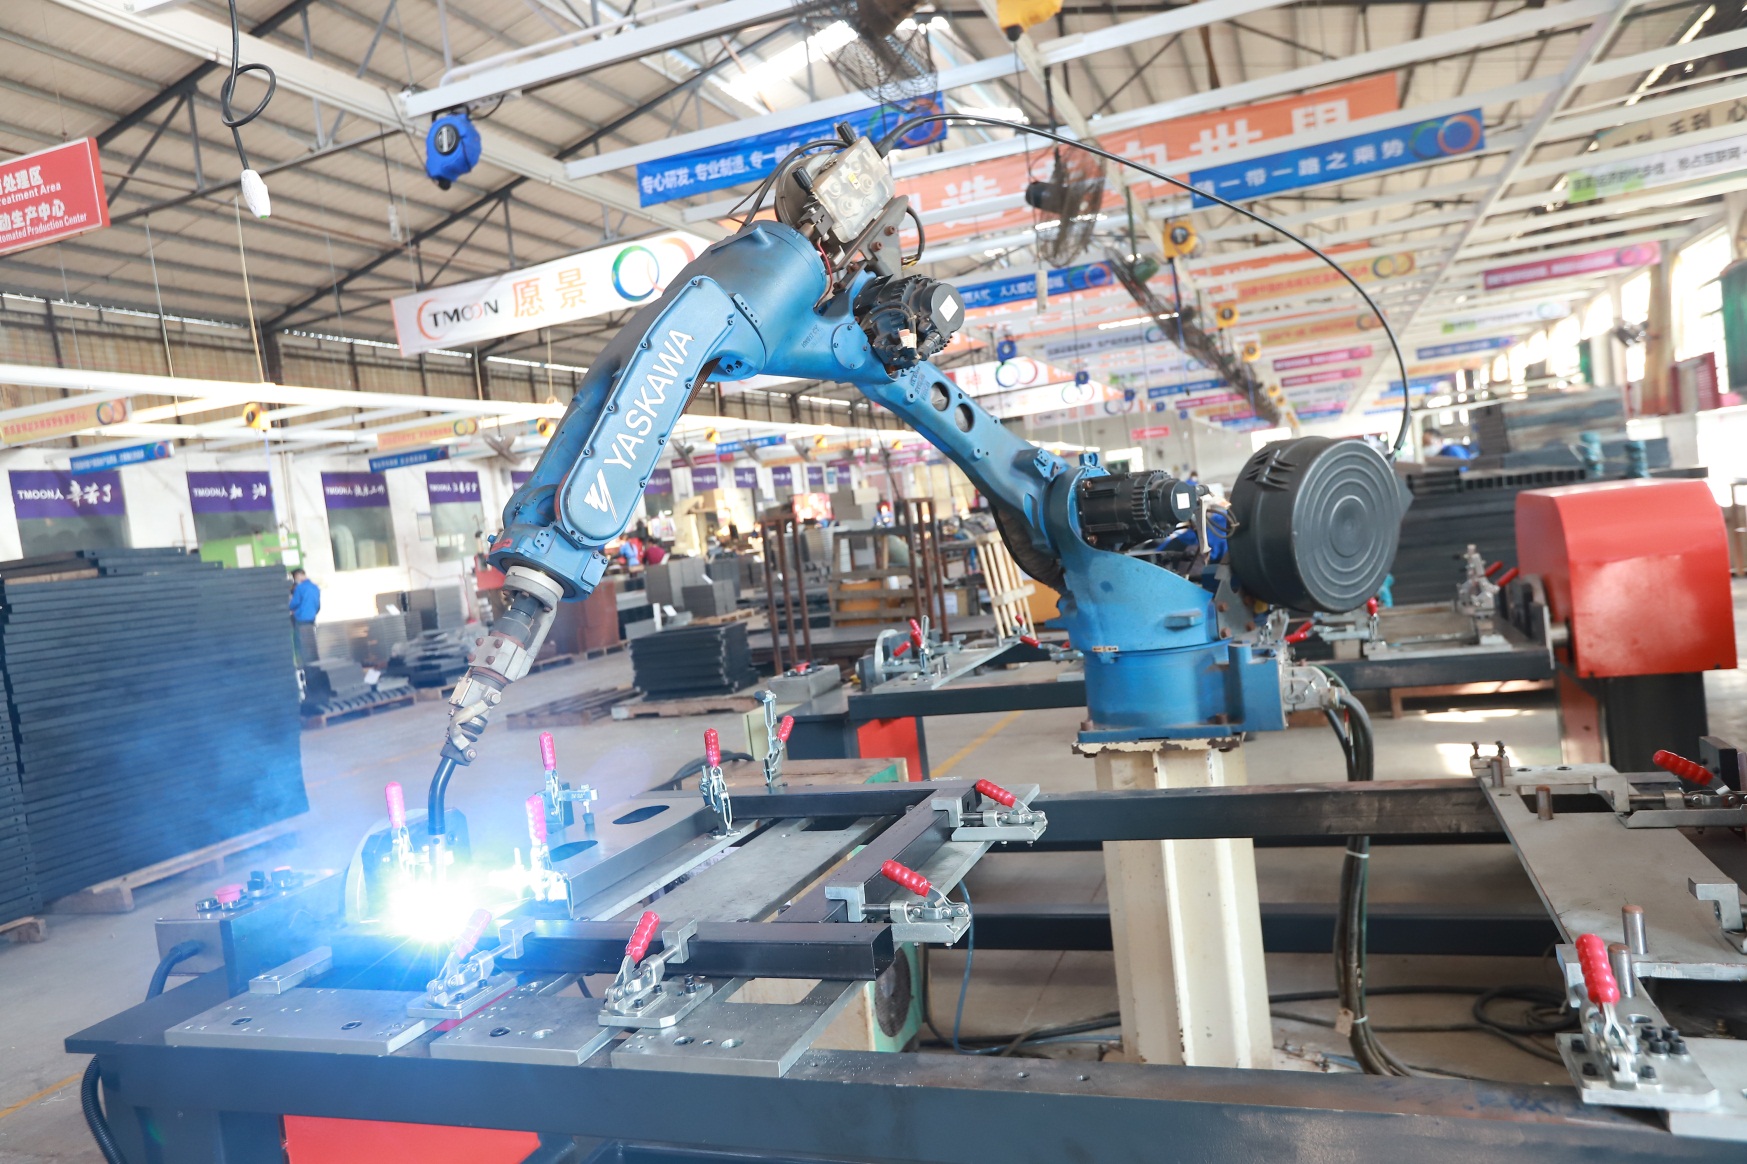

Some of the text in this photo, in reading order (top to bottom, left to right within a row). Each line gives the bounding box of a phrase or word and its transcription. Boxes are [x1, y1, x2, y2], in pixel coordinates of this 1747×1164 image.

[0, 165, 43, 195] 处理区
[0, 182, 61, 206] eatment Area
[0, 212, 87, 243] tomated Production Center
[428, 267, 587, 328] TMOON 愿景
[603, 329, 695, 469] YASKAWA
